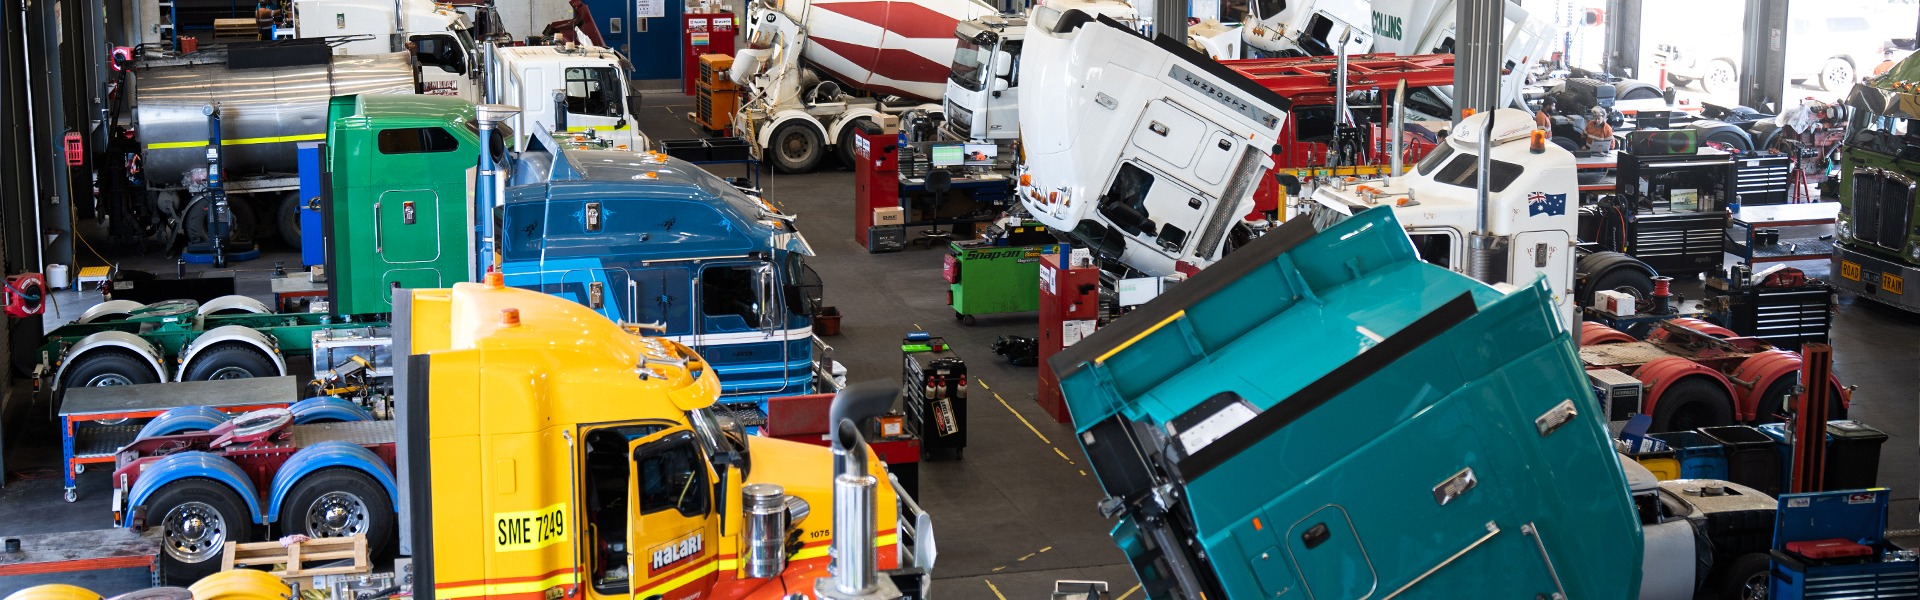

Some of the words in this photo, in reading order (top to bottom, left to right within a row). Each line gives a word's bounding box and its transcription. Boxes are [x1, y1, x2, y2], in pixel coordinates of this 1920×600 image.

[1372, 10, 1402, 41] COLLINS
[1184, 74, 1248, 111] KENWORTH
[965, 250, 1021, 261] Snap-on
[1843, 263, 1859, 279] ROAD
[1883, 275, 1902, 293] TRAIN
[498, 517, 531, 546] SME
[535, 509, 564, 543] 7249
[810, 529, 830, 539] 1075
